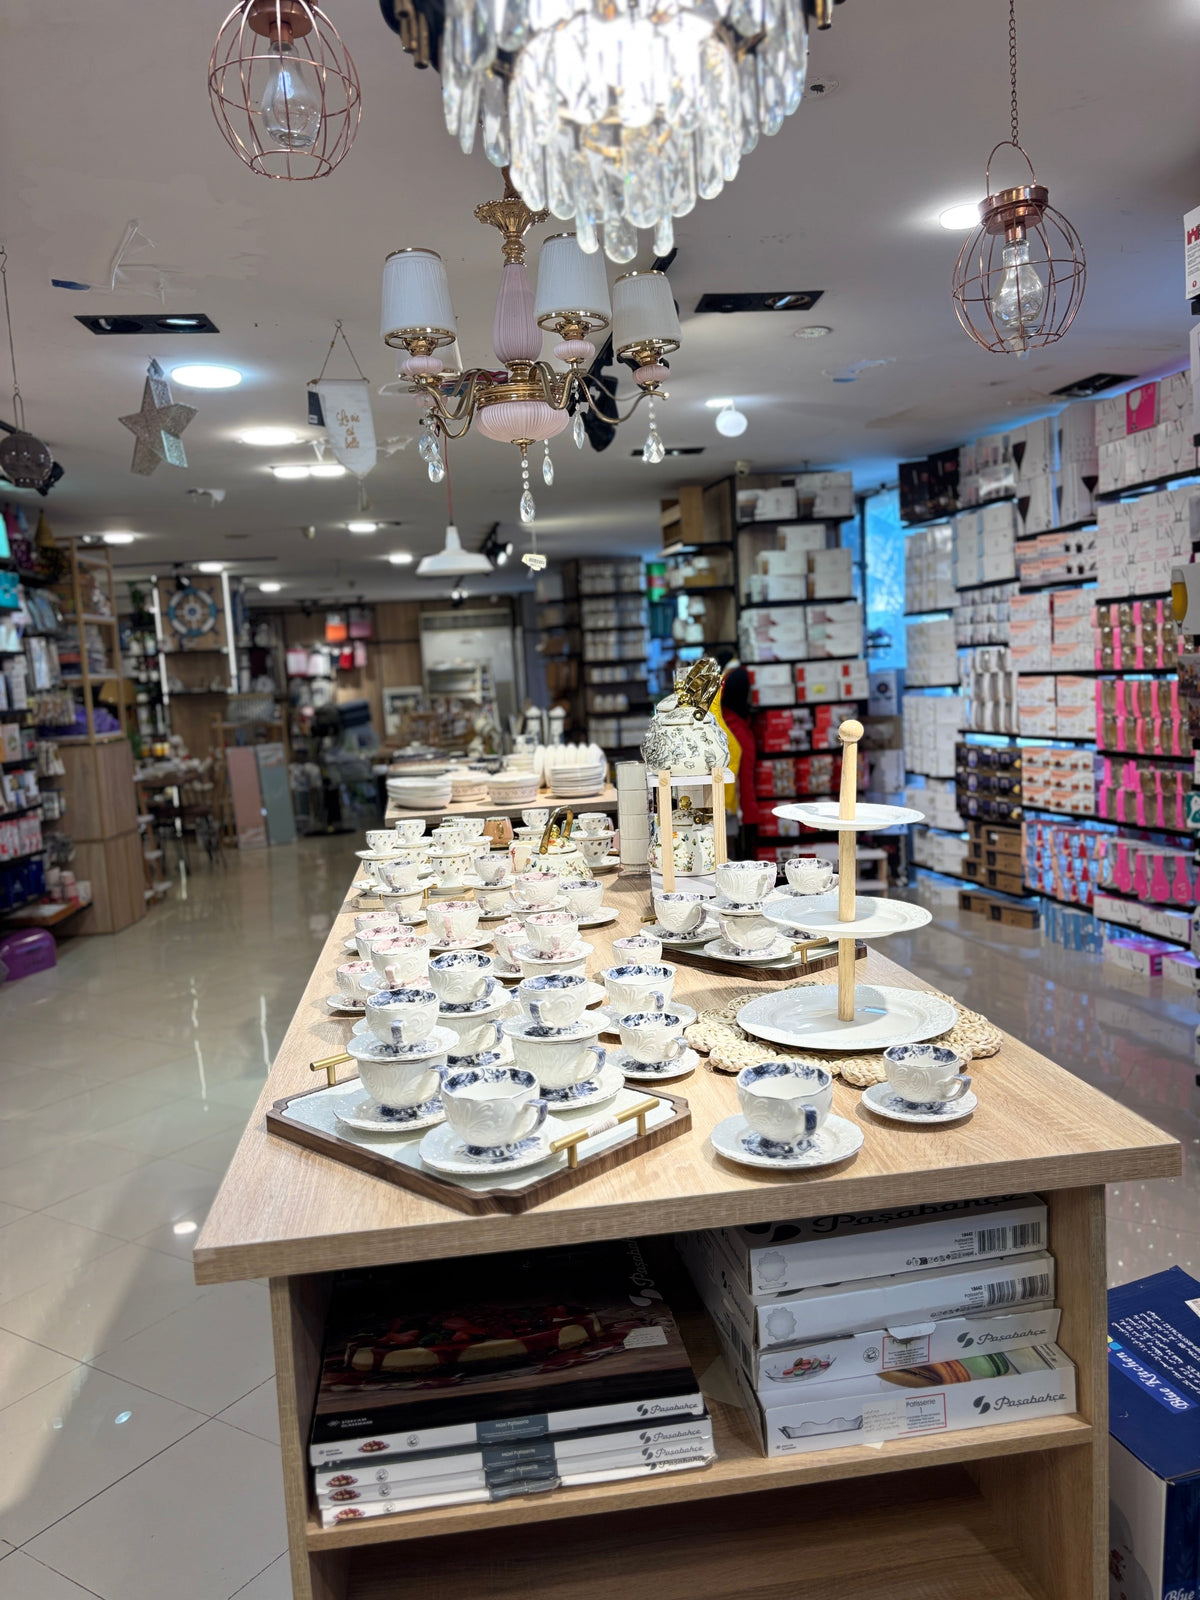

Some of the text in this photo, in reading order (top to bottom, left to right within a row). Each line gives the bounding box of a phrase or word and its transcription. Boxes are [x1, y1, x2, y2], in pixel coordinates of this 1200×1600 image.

[977, 1328, 1048, 1345] Paşabahçe
[1116, 1351, 1190, 1410] Blue Kitchen
[994, 1392, 1068, 1411] Paşabahçe
